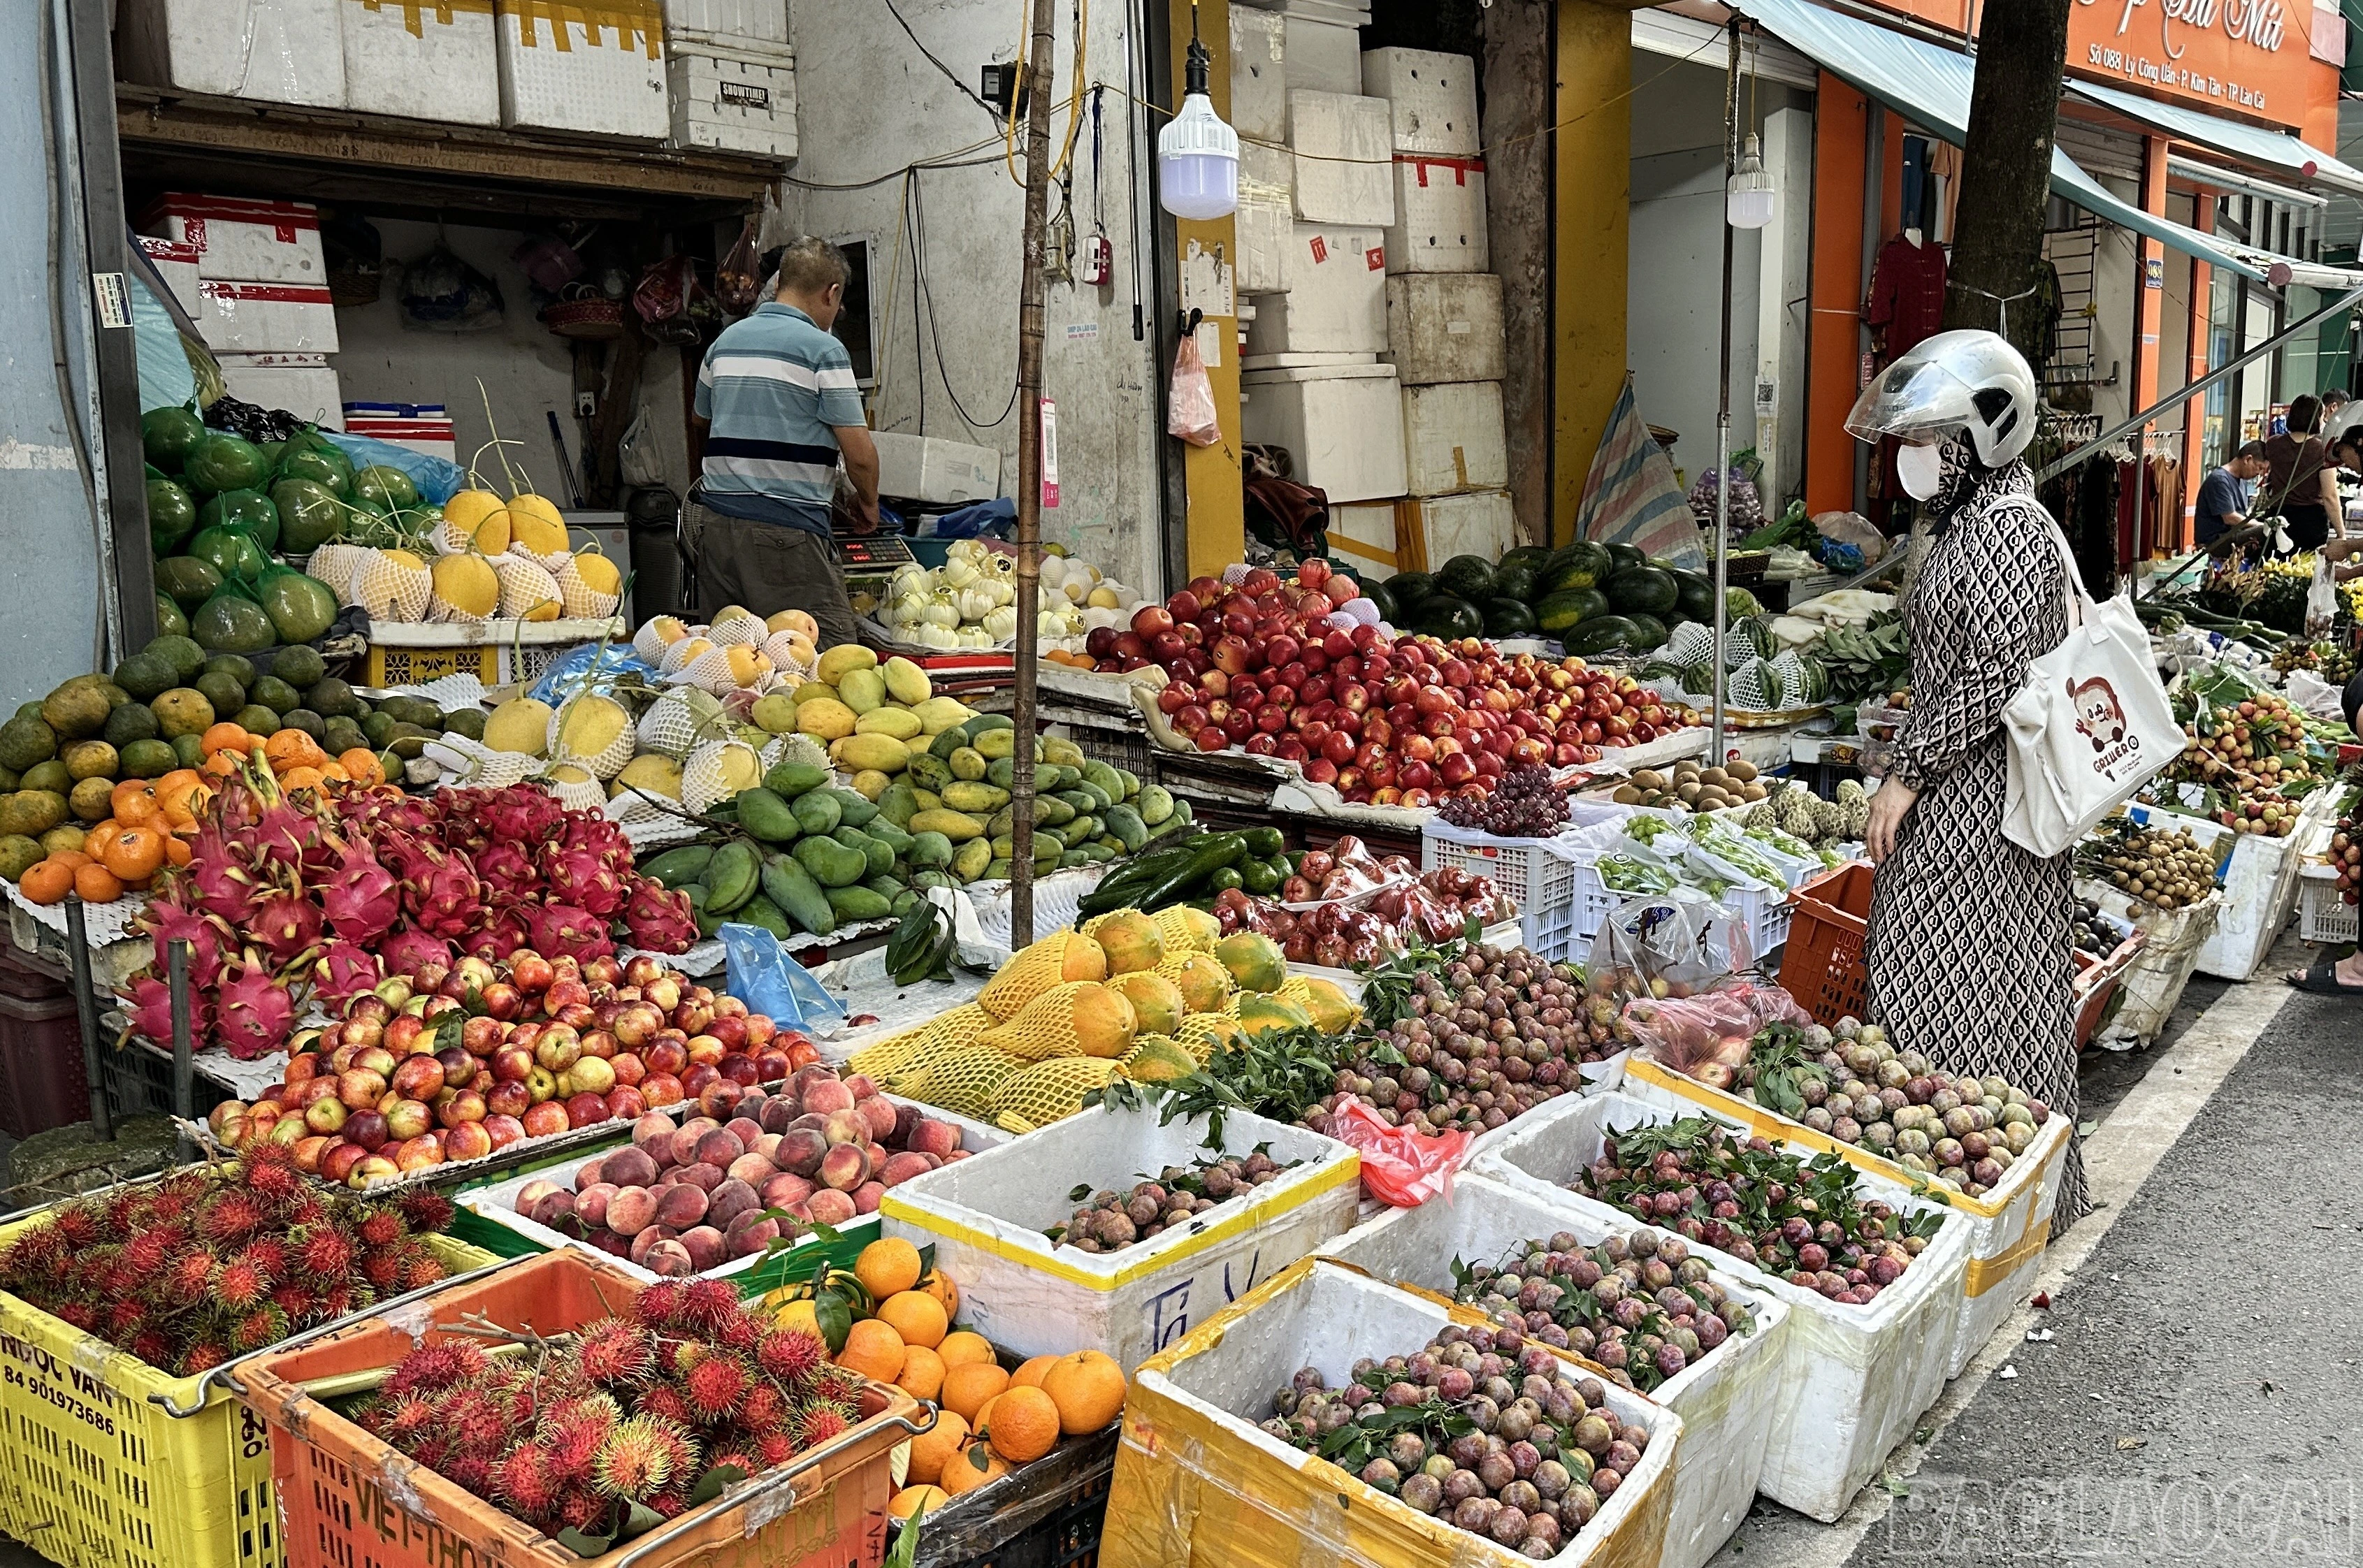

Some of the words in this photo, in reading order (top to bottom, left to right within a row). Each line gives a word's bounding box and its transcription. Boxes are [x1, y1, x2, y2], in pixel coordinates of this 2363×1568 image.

[2088, 43, 2102, 64] Số
[2104, 48, 2122, 70] 088
[2125, 53, 2135, 79] Lý
[2138, 57, 2158, 85] Công
[2181, 69, 2188, 88] P.
[2190, 72, 2205, 92] Kim
[2208, 76, 2220, 96] Tân
[2239, 86, 2253, 106] Lào
[2254, 90, 2265, 110] Cai
[4, 1365, 24, 1388] 84
[29, 1377, 115, 1436] 901973686
